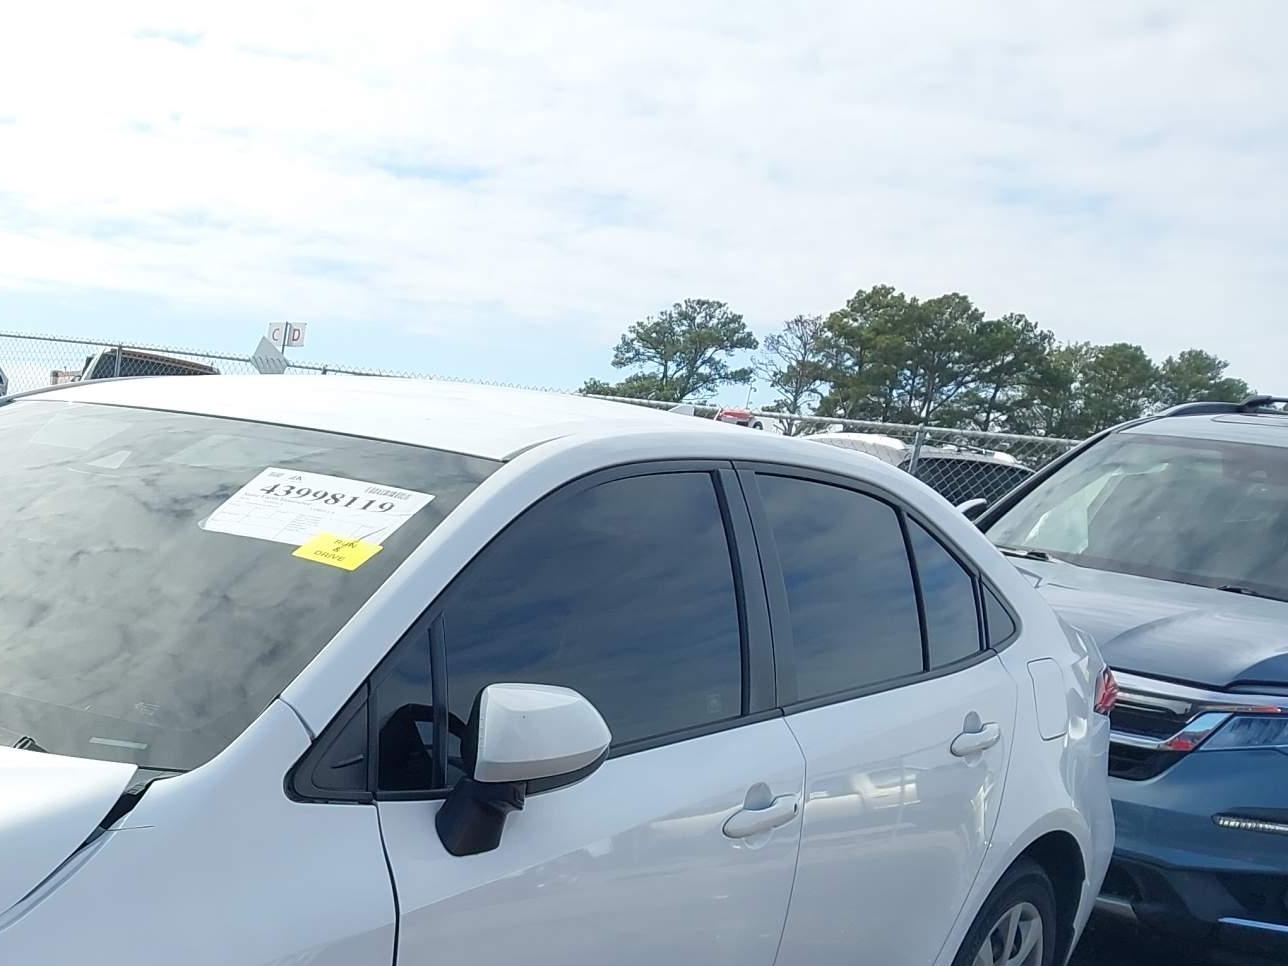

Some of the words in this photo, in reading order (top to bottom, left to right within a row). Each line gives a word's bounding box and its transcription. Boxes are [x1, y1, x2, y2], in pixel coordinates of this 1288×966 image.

[272, 328, 280, 342] C
[292, 328, 301, 342] D
[259, 483, 395, 513] 43998119
[313, 550, 346, 562] DRIVE
